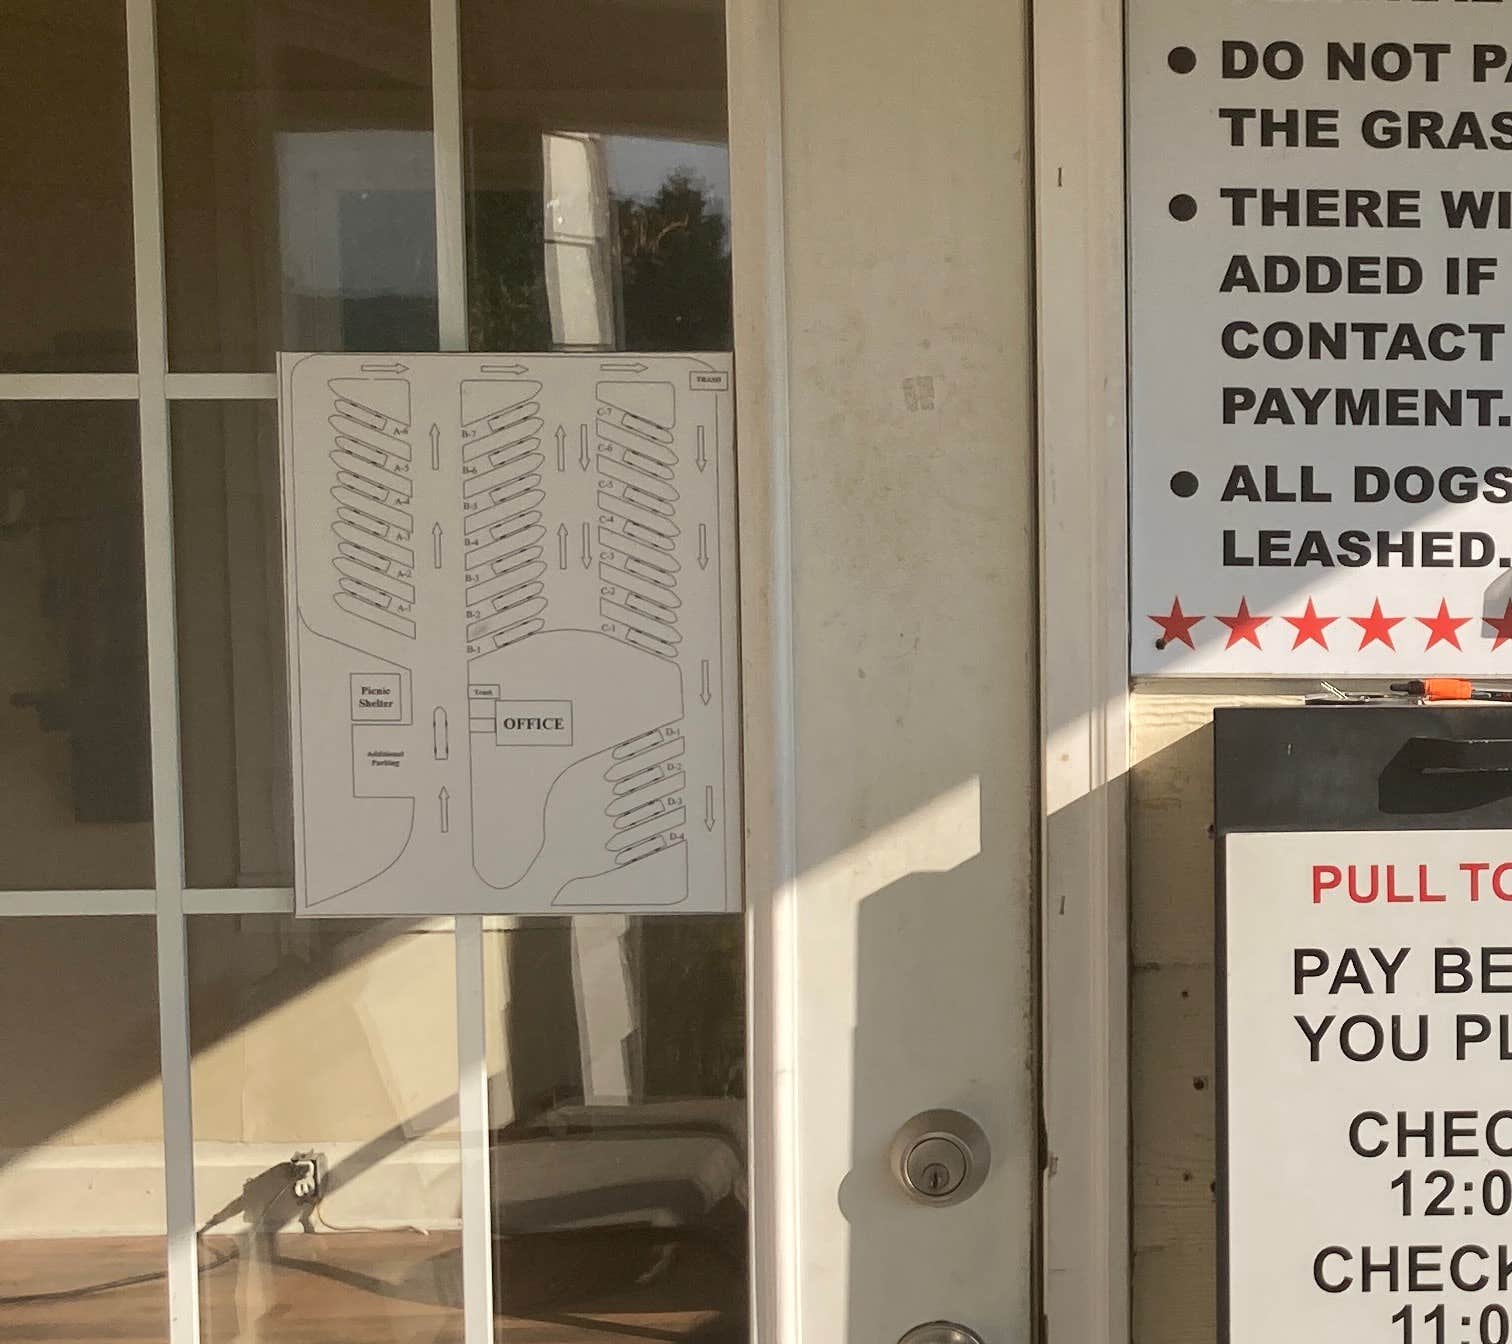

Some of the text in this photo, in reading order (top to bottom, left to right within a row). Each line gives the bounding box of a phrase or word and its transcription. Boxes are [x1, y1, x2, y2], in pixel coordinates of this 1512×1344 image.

[1222, 40, 1303, 80] DO
[1328, 42, 1450, 81] NOT
[1219, 108, 1339, 148] THE
[1220, 188, 1420, 228] THERE
[1220, 255, 1422, 294] ADDED
[1447, 258, 1497, 295] IF
[1222, 321, 1505, 361] CONTACT
[1223, 388, 1510, 426] PAYMENT.
[1221, 465, 1331, 502] ALL
[1223, 530, 1510, 567] LEASHED.
[359, 699, 393, 708] Shelter
[361, 687, 391, 696] Picnic
[503, 717, 565, 731] OFFICE
[1313, 865, 1445, 903] PULL
[1294, 948, 1410, 995] PAY
[1294, 1015, 1427, 1061] YOU
